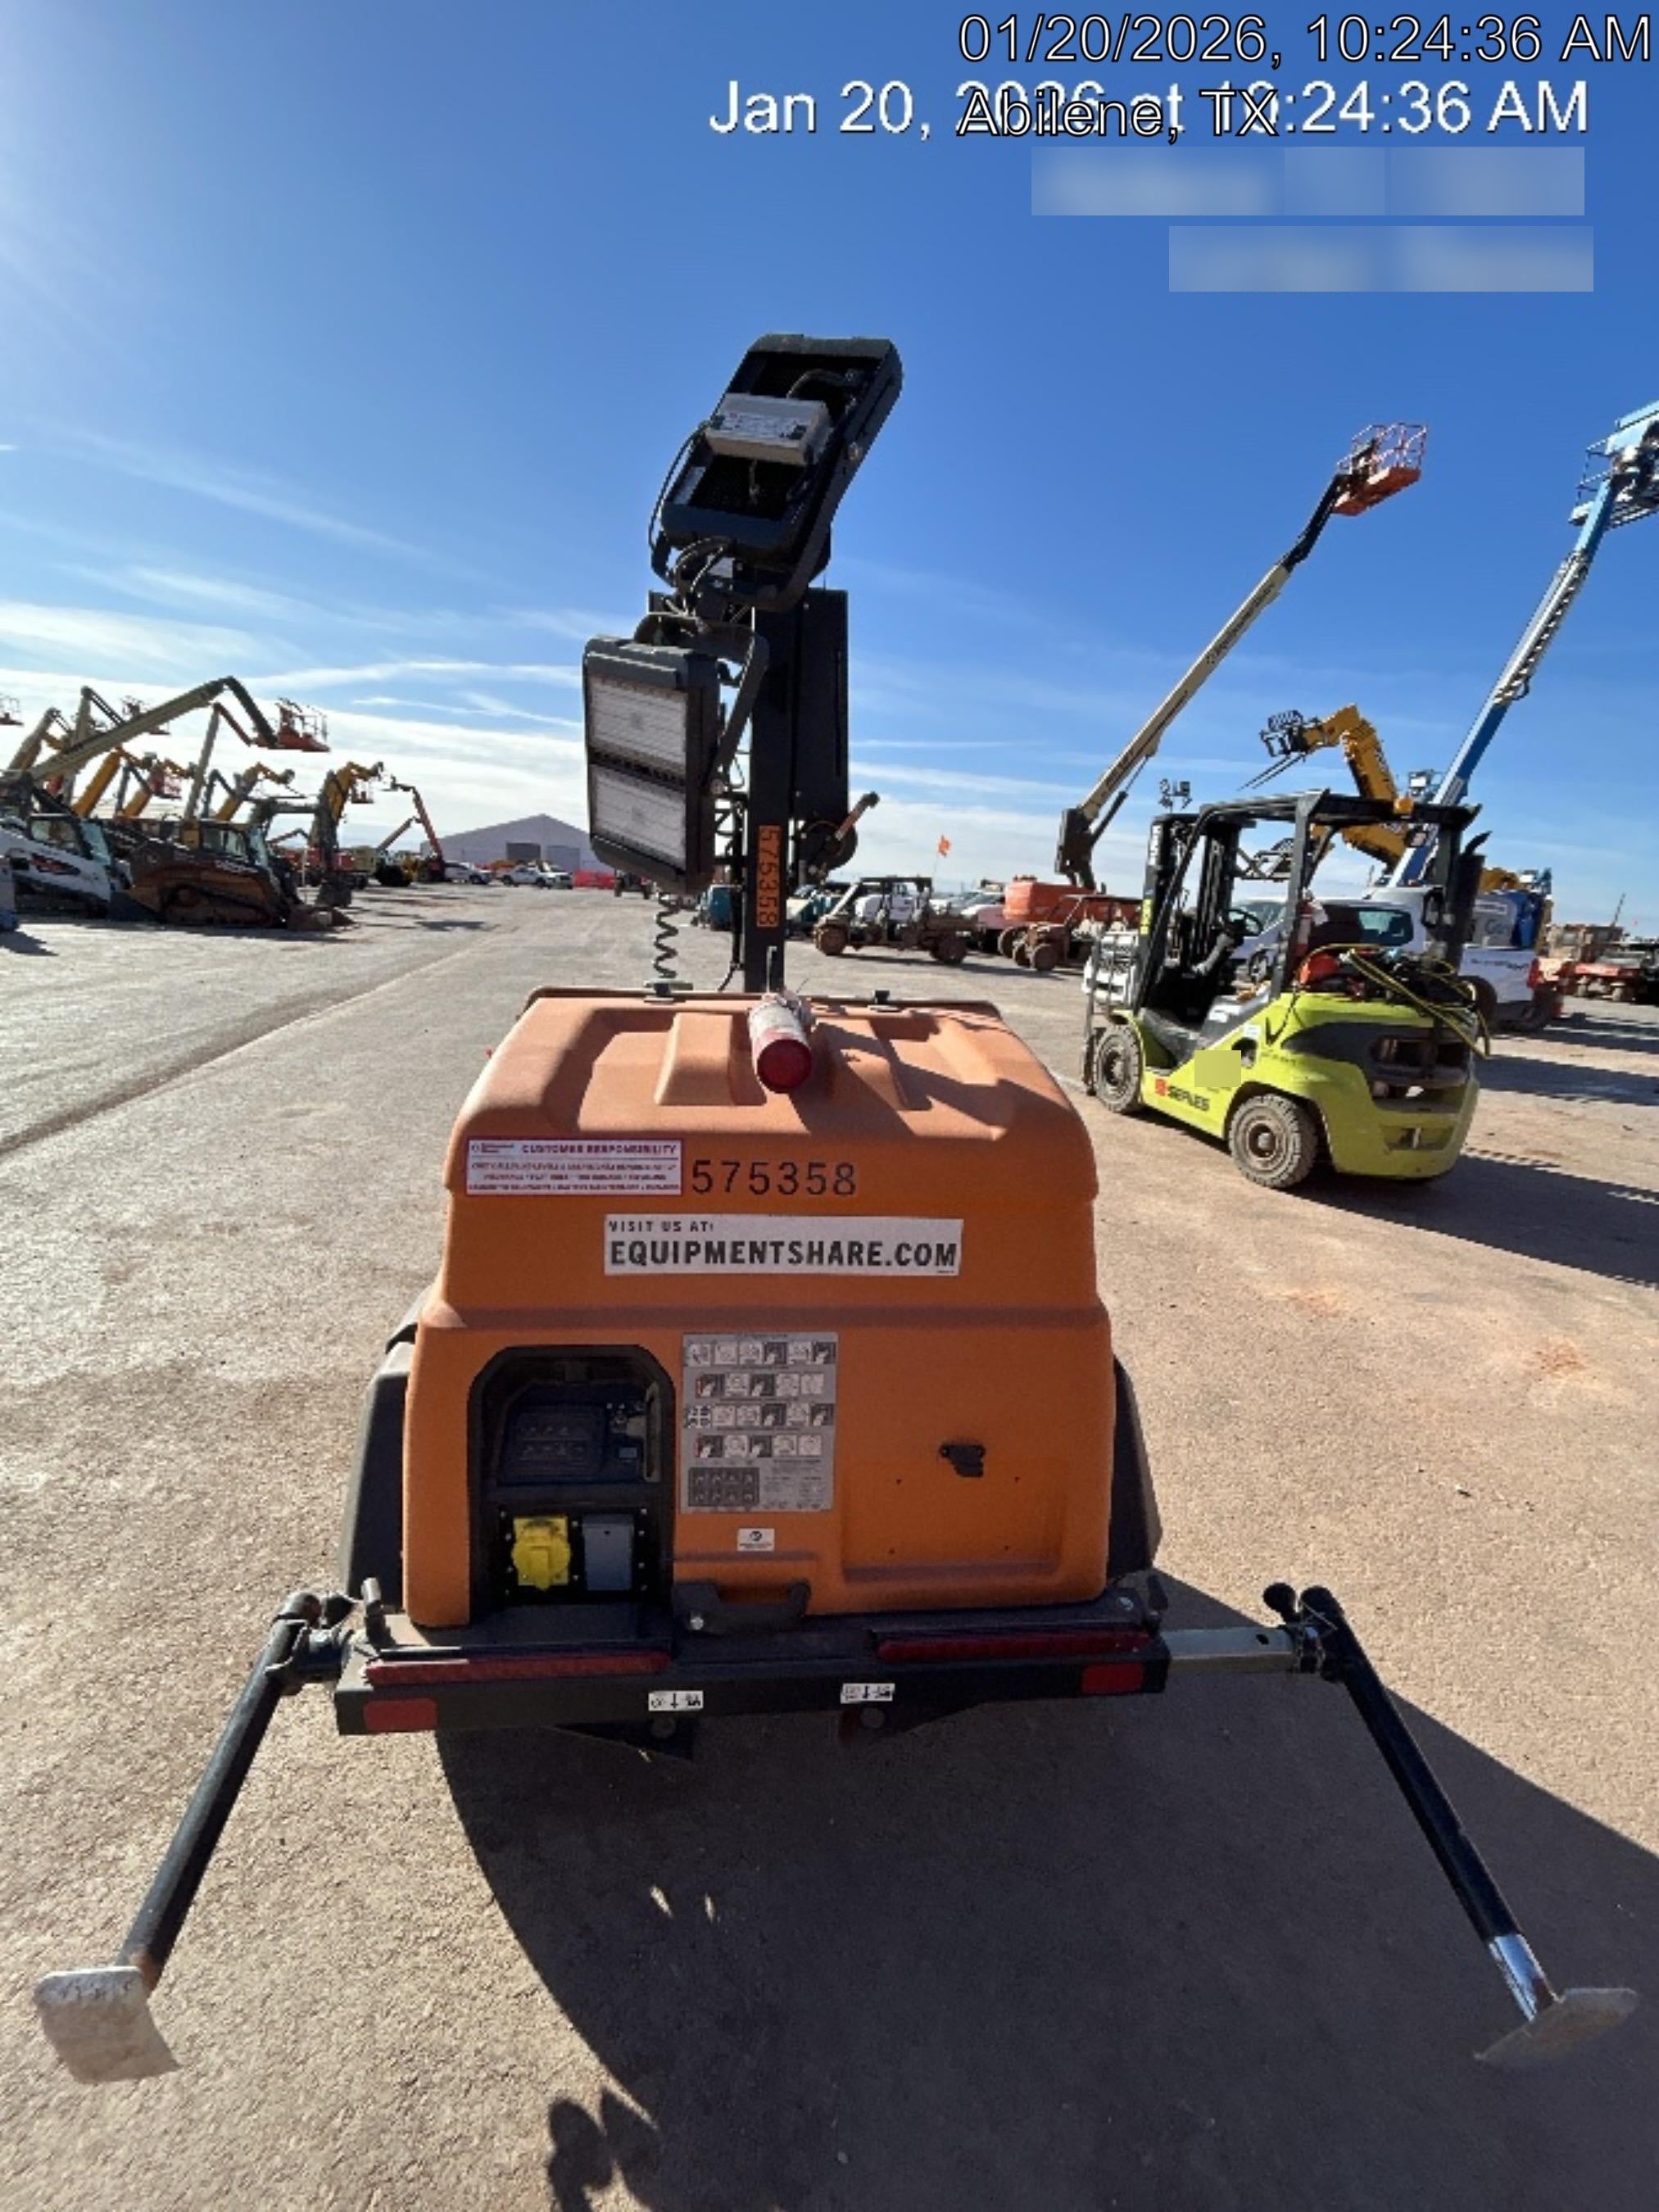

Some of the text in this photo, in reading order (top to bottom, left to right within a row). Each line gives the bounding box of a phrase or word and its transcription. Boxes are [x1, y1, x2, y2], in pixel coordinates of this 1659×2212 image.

[759, 827, 778, 926] 575358
[691, 1158, 856, 1196] 575358
[609, 1221, 714, 1232] VISIT US AT:
[610, 1240, 958, 1267] EQUIPMENTSHARE.COM
